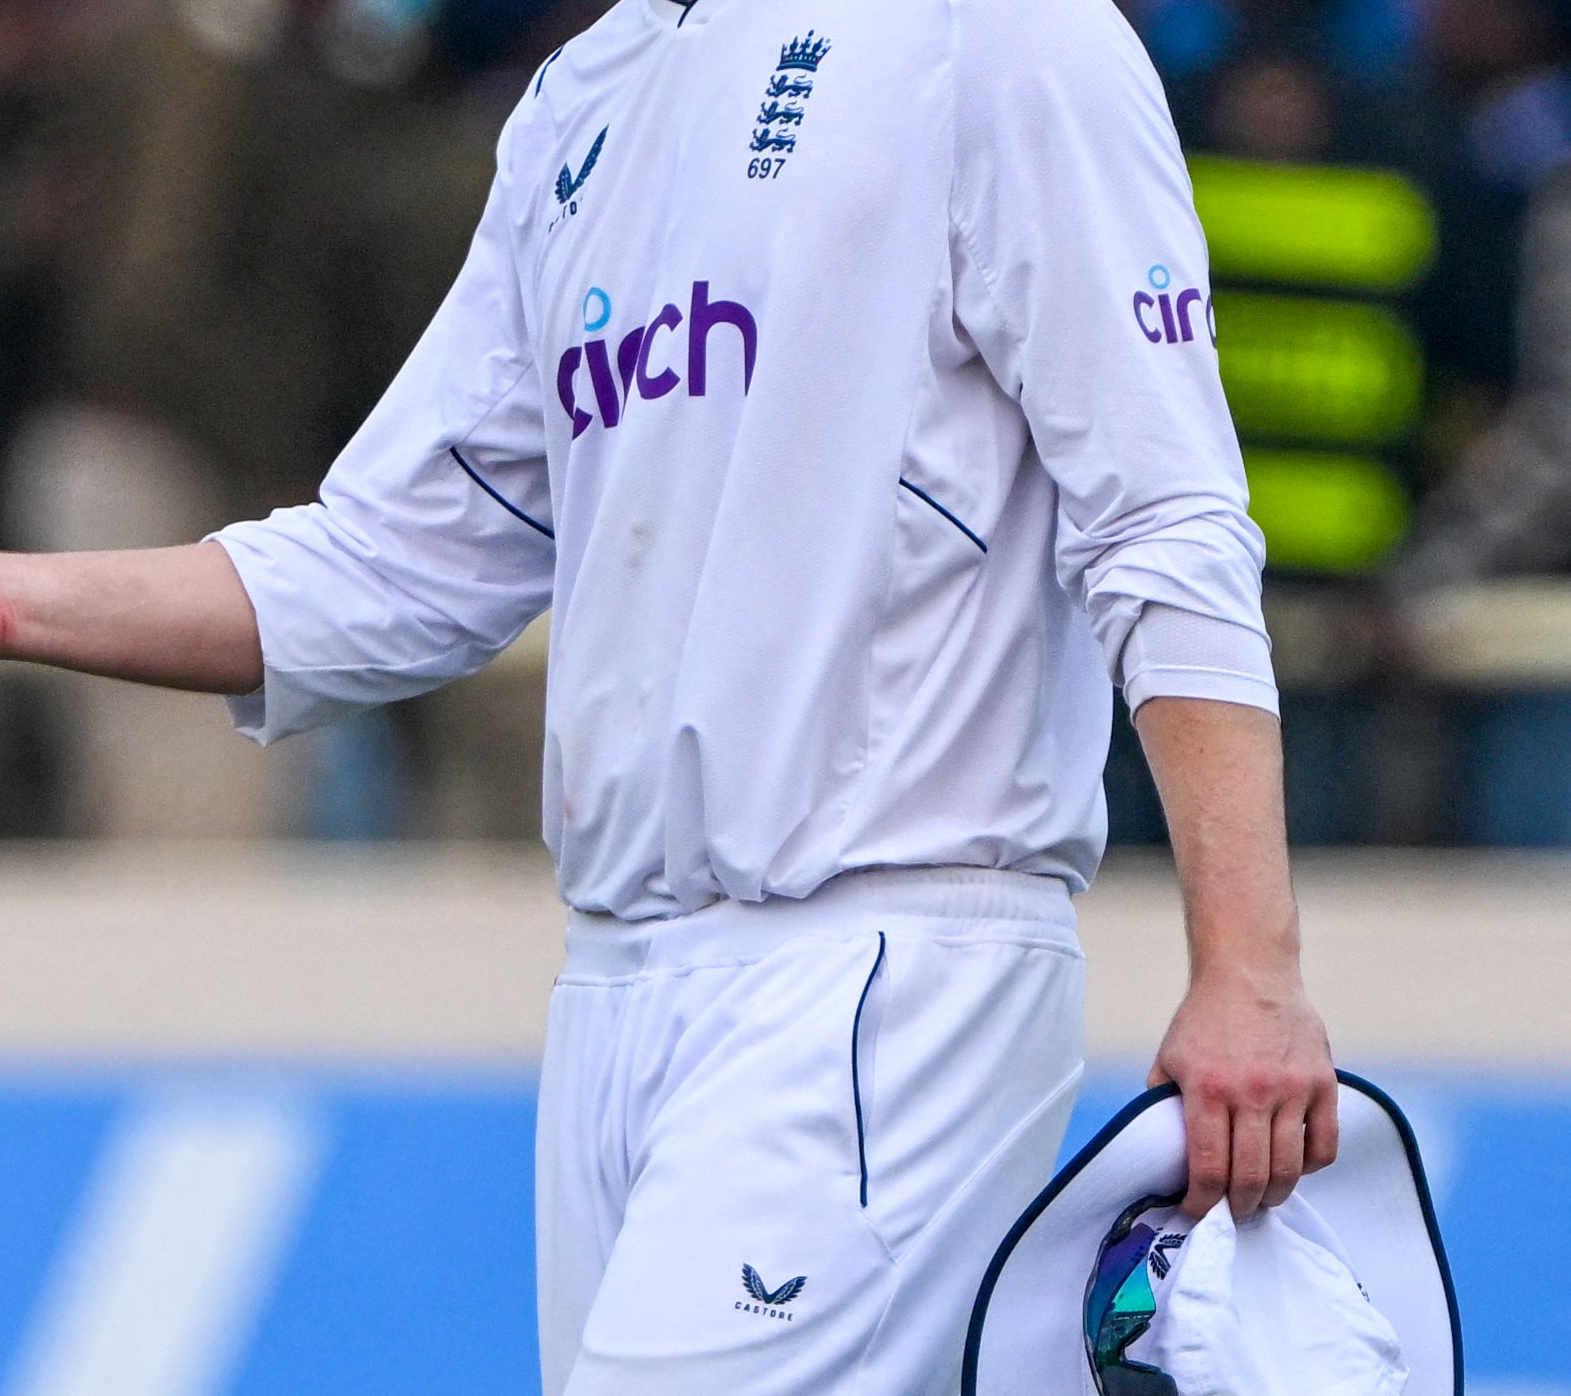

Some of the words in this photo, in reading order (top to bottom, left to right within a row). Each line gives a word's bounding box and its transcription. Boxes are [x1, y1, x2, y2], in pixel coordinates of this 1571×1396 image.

[747, 157, 786, 180] 697
[557, 280, 758, 442] cinch
[734, 1301, 793, 1322] CASTORE
